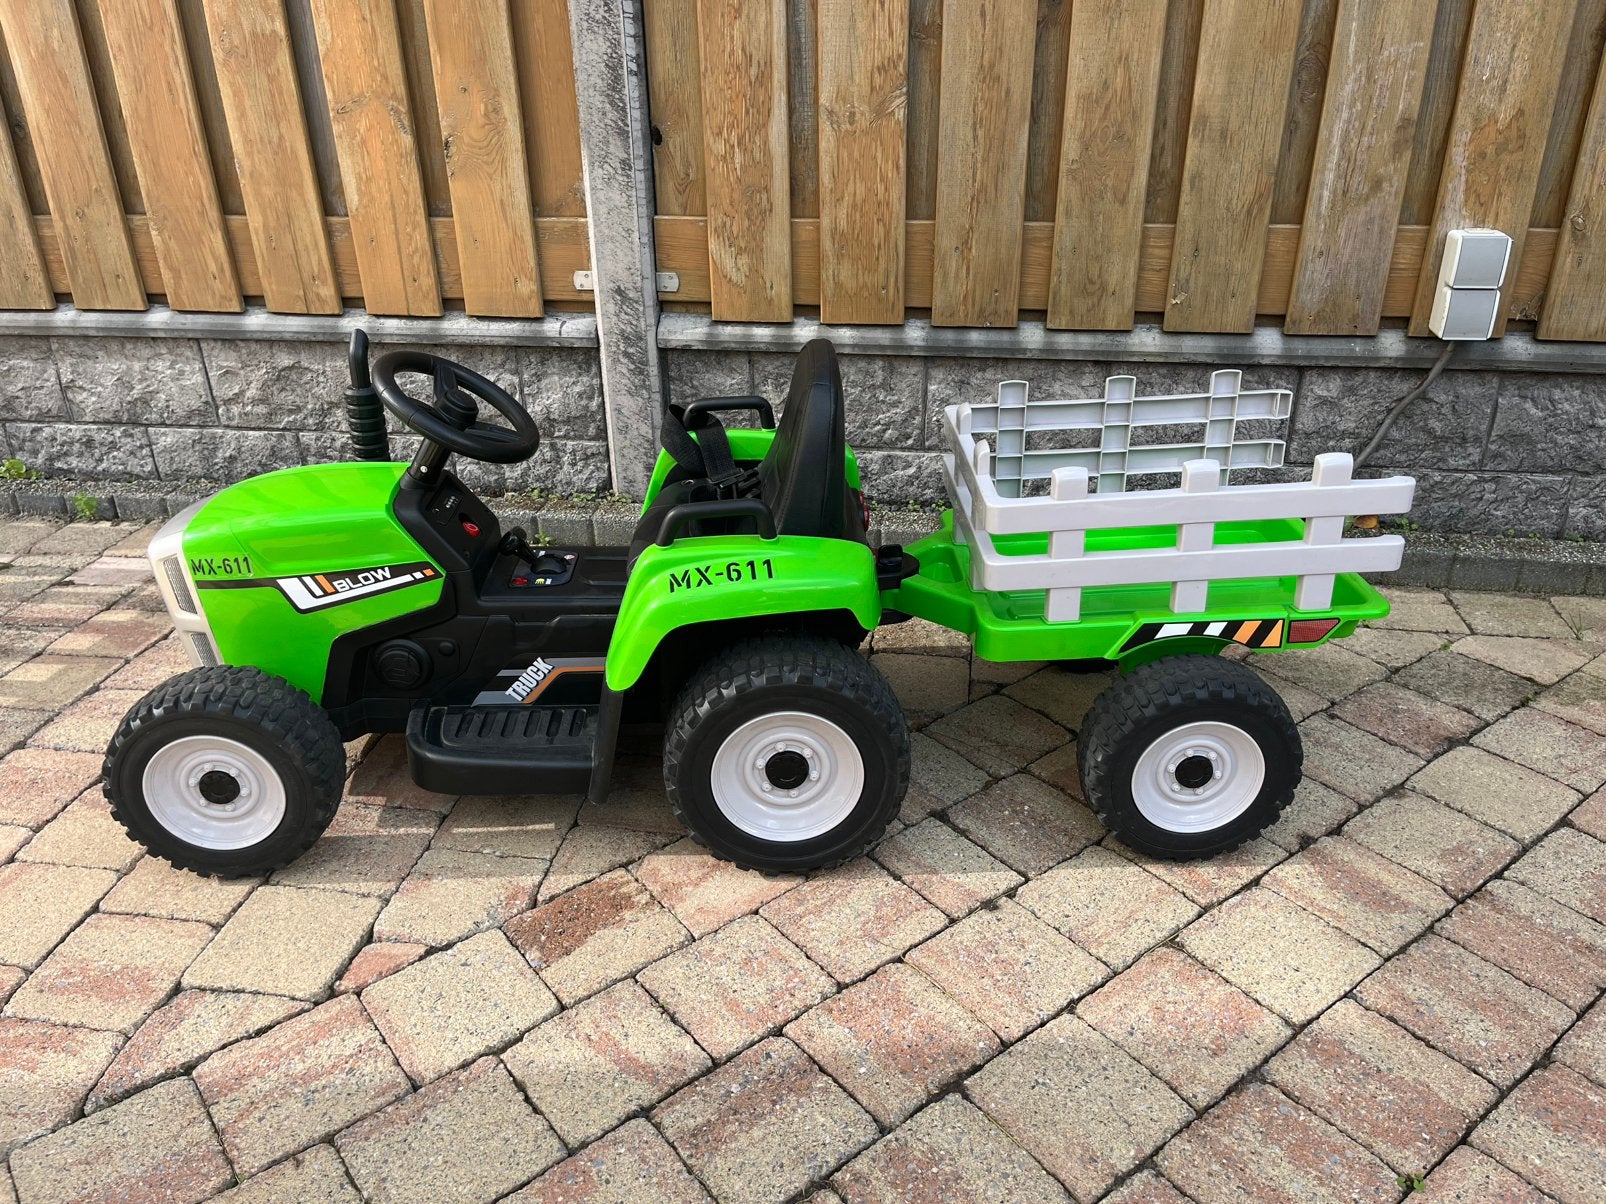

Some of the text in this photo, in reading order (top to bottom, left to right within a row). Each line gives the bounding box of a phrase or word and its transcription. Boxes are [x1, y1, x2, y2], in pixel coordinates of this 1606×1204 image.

[190, 556, 252, 576] MX-611
[332, 566, 391, 593] BLOW
[669, 558, 774, 593] MX-611
[504, 656, 554, 702] TRUCK
